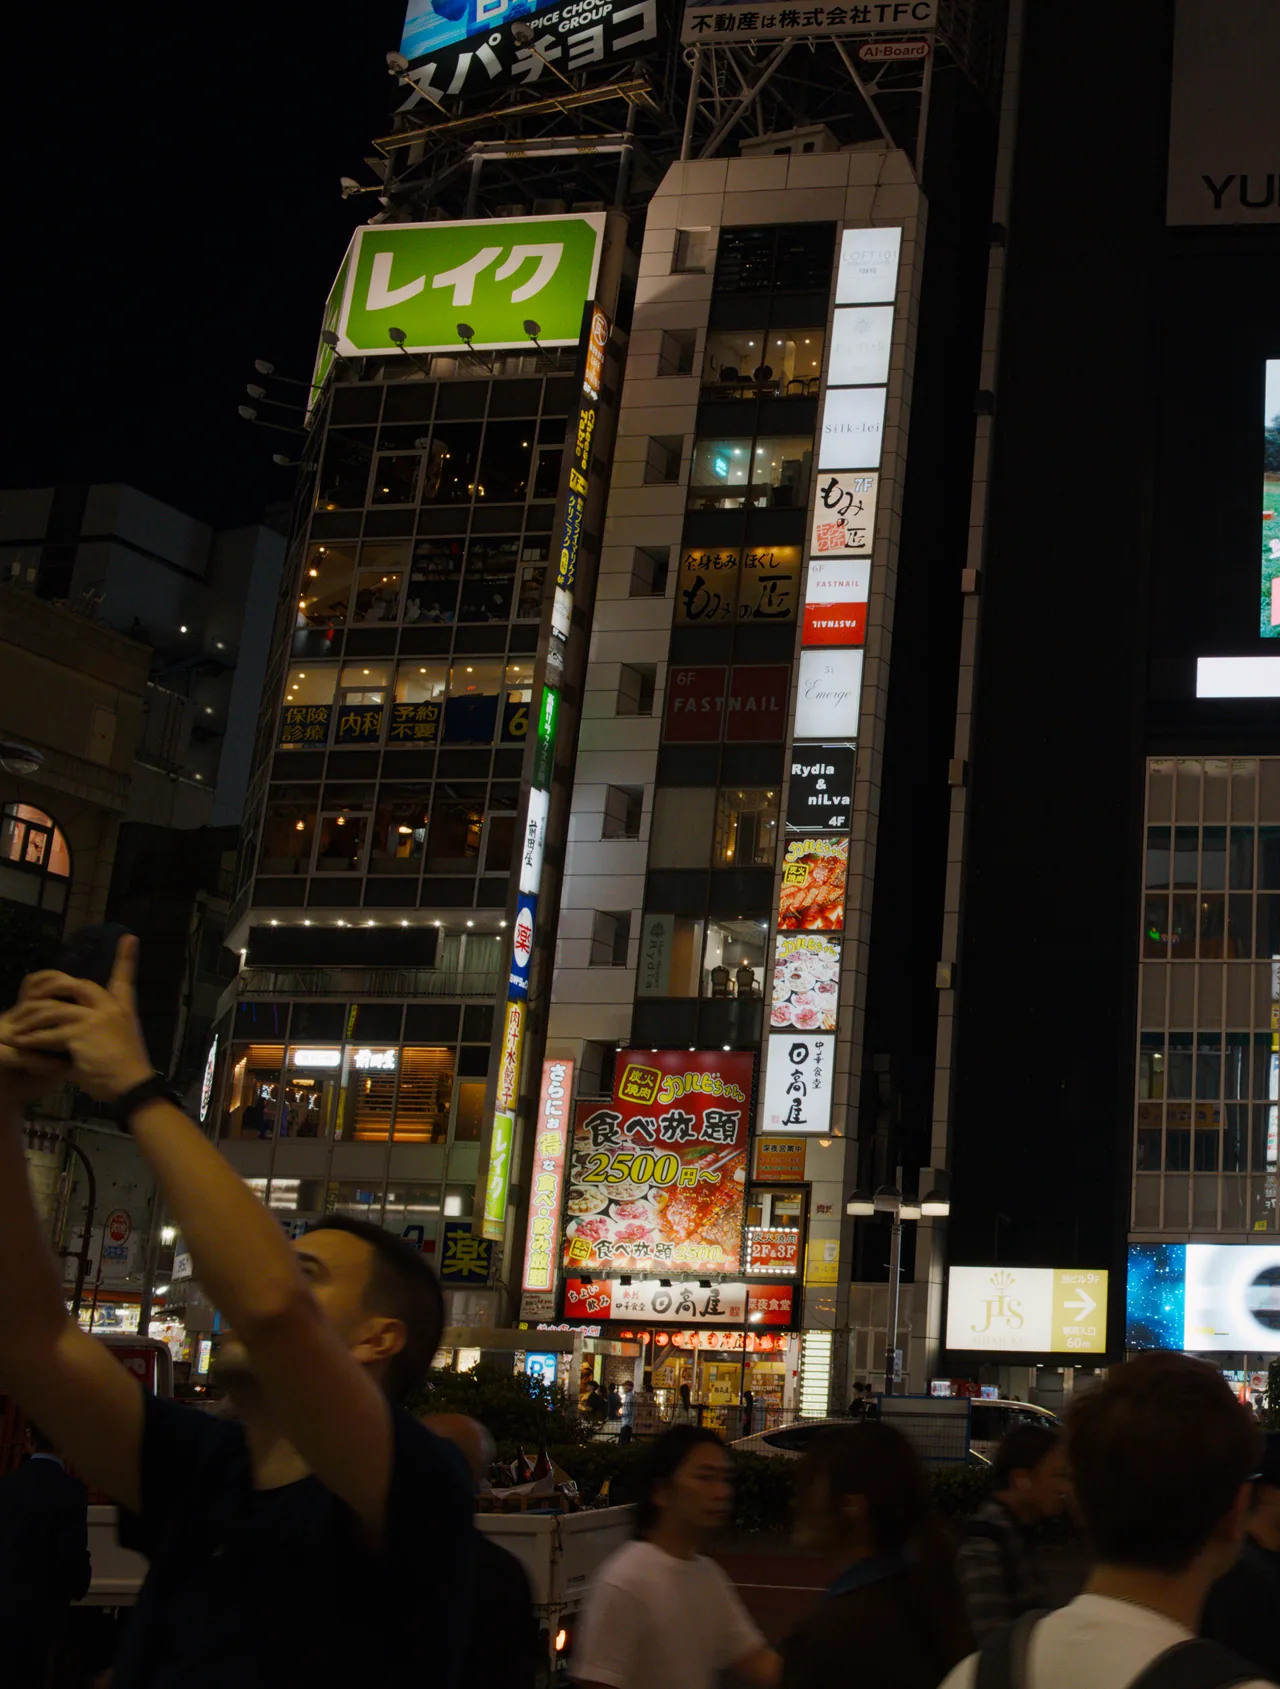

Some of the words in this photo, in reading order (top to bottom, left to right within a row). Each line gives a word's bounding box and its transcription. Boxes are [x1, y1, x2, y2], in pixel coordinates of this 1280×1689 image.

[526, 10, 560, 30] PICE
[557, 4, 613, 33] GROUP
[691, 2, 931, 34] 不動産は株式会社TFC
[365, 243, 564, 311] レイク
[575, 409, 589, 458] Table
[580, 408, 596, 471] Cheese
[853, 477, 874, 493] 7F
[684, 553, 781, 572] 全身もみほぐし
[816, 581, 861, 589] FASTNAIL
[682, 575, 793, 620] もみの匠
[676, 672, 696, 685] 6F
[804, 678, 852, 708] Emerge
[673, 695, 780, 713] FASTNAIL
[286, 707, 328, 724] 保険
[395, 706, 439, 722] 予約
[282, 724, 325, 741] 診療
[339, 711, 382, 738] 内科
[391, 723, 436, 739] 不要
[791, 763, 835, 778] Rydia
[815, 778, 827, 791] &
[808, 793, 851, 806] niLva
[828, 816, 846, 827] 4F
[785, 838, 848, 863] カルビちゃん
[515, 923, 532, 955] 薬
[778, 936, 838, 960] カルビちゃん
[812, 1041, 825, 1089] 中華食堂
[629, 1069, 655, 1087] 炭火
[782, 1042, 810, 1126] 日高屋
[625, 1083, 652, 1100] 焼肉
[658, 1071, 746, 1105] カルビちゃん
[583, 1107, 741, 1149] 食べ放題
[490, 1129, 507, 1200] レイク
[444, 1229, 490, 1277] 薬
[592, 1240, 675, 1262] 食べ放題
[752, 1244, 797, 1258] 2F&3F
[568, 1284, 600, 1302] ちょい
[650, 1287, 726, 1318] 日高屋
[587, 1295, 611, 1312] 飲み
[615, 1303, 646, 1312] 中華食堂
[1066, 1337, 1091, 1349] 60m
